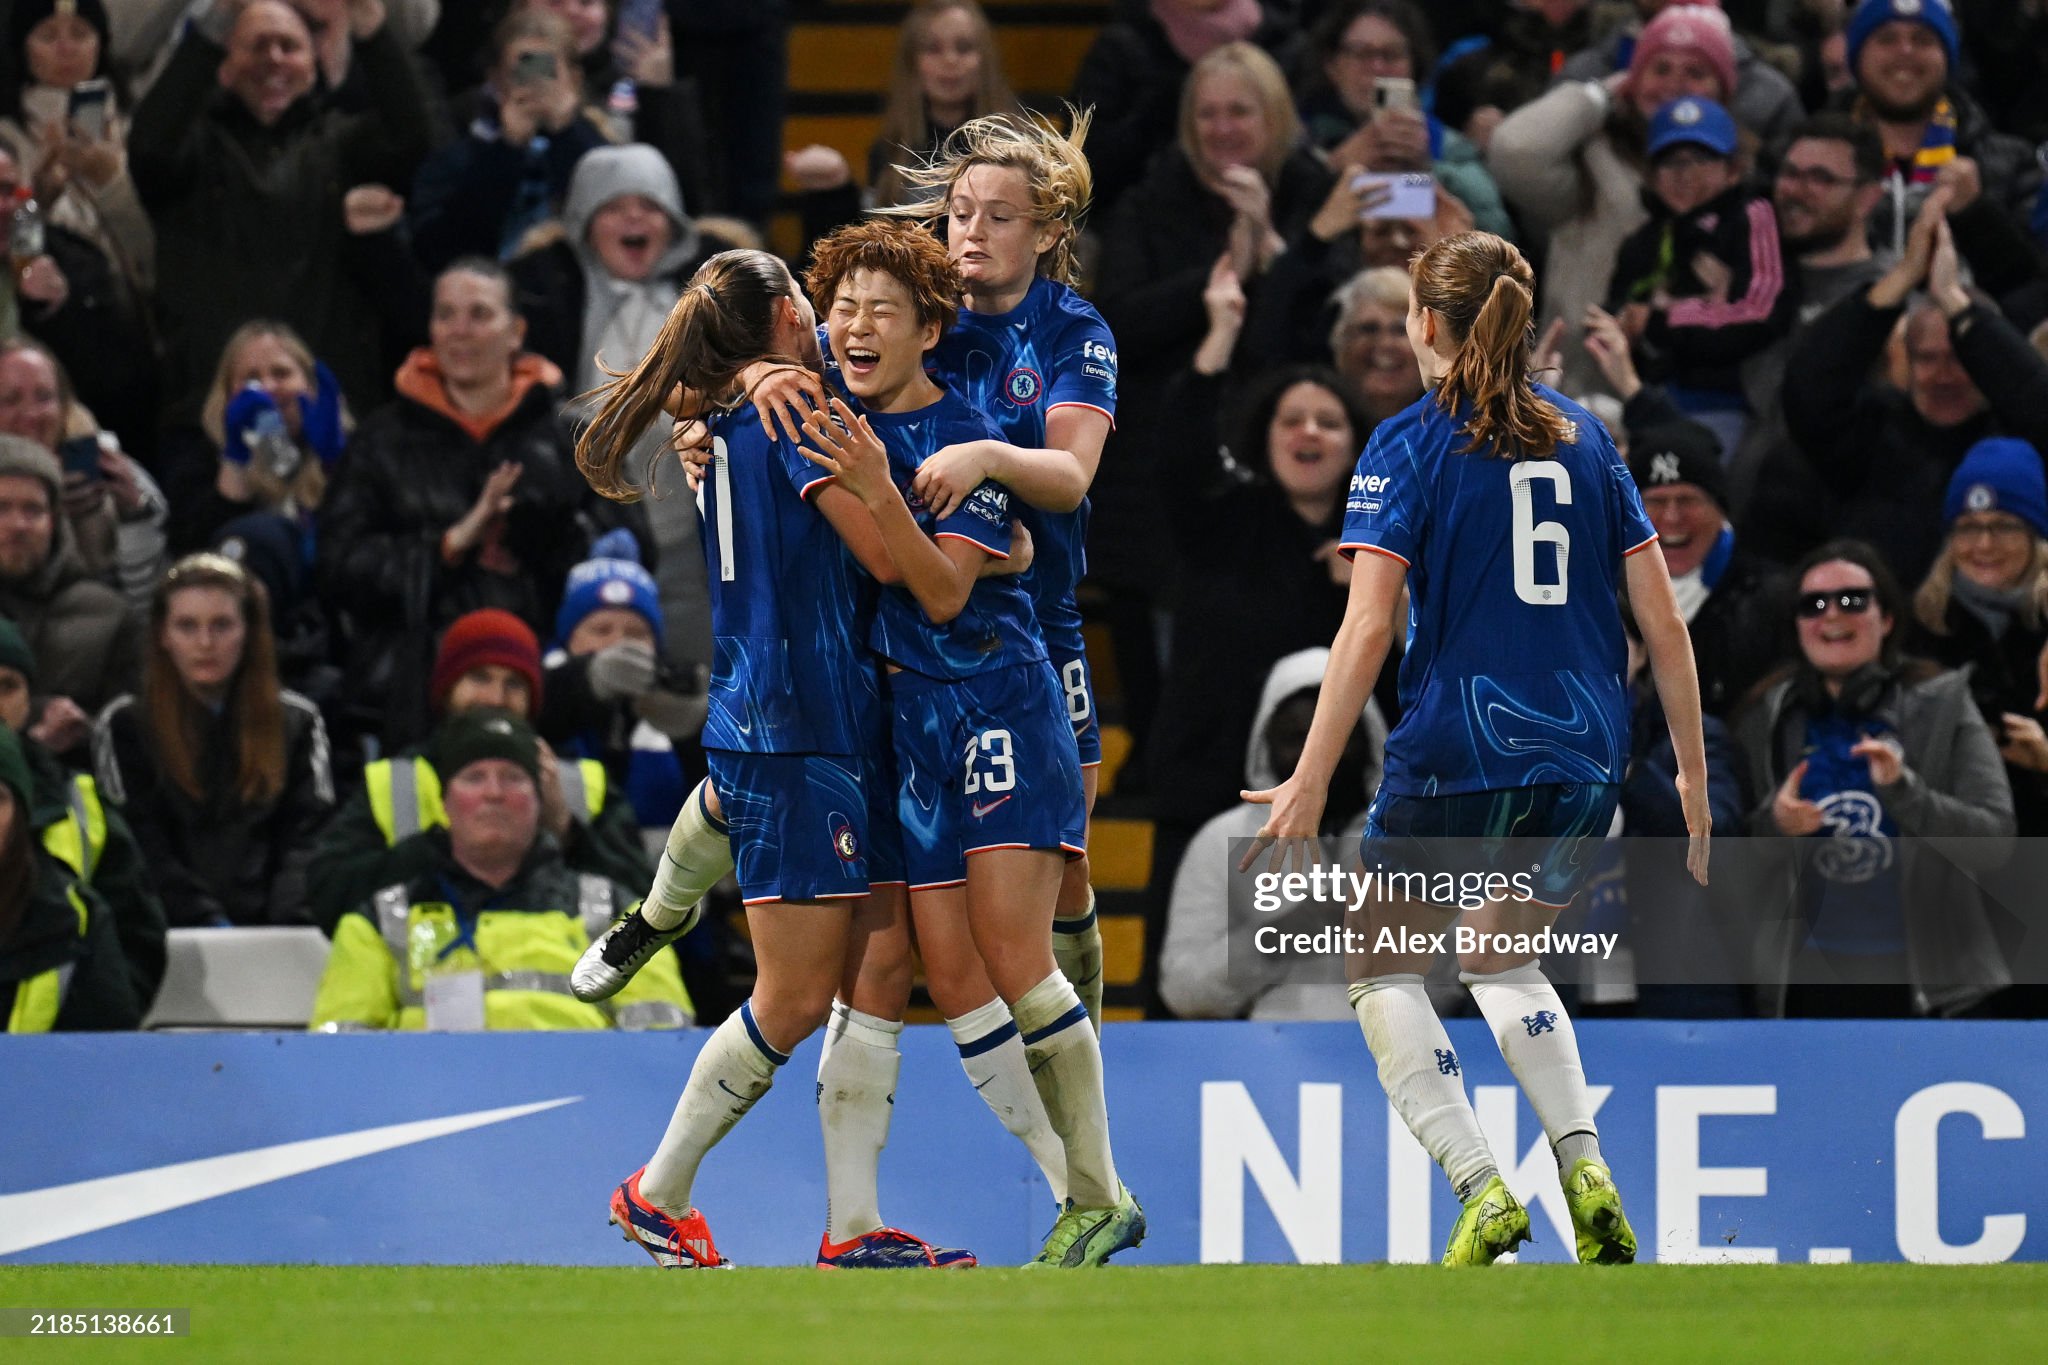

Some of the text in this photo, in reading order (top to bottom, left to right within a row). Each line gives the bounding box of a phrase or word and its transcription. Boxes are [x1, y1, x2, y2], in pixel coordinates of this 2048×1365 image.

[1509, 461, 1573, 605] 6
[1062, 659, 1090, 722] 8
[963, 729, 1016, 794] 23
